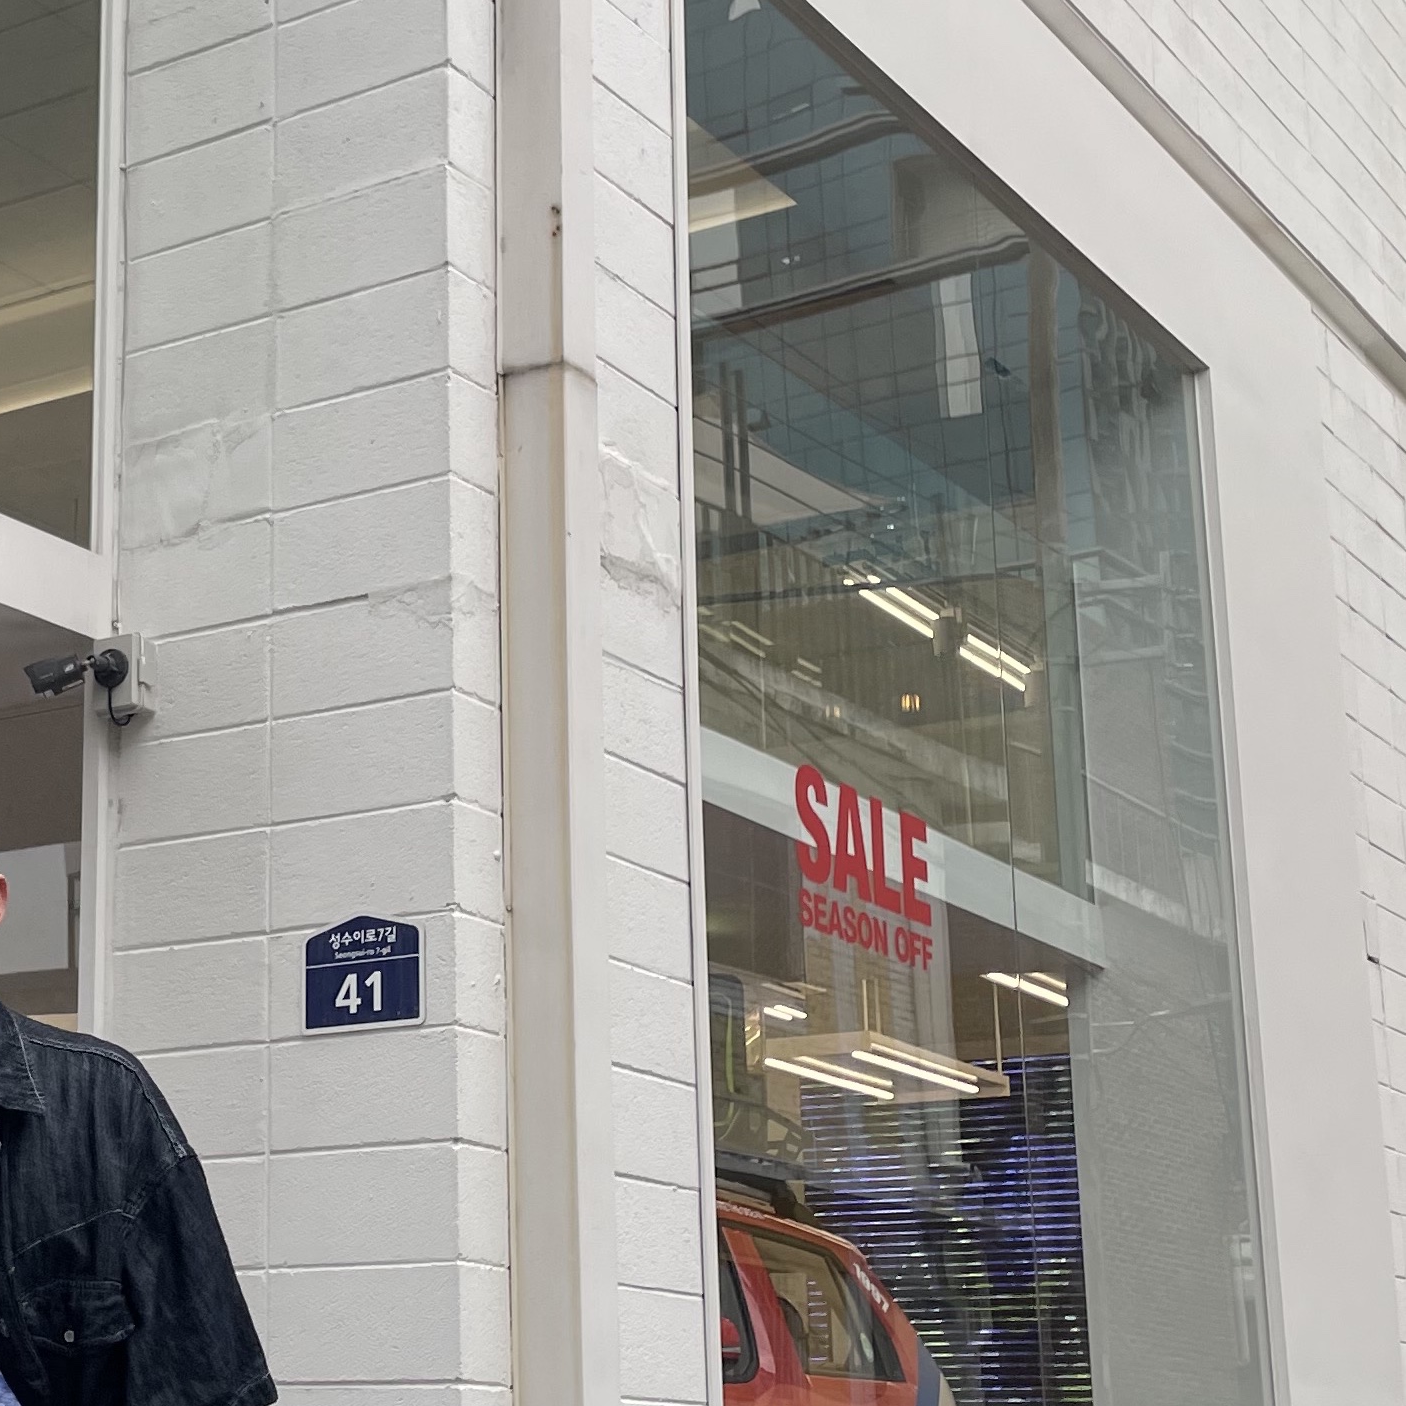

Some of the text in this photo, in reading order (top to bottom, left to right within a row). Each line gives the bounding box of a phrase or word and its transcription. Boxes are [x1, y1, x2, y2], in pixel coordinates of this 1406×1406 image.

[795, 764, 932, 927] SALE
[329, 925, 397, 950] 성수이로7길
[799, 888, 933, 971] SEASON OFF
[335, 970, 382, 1014] 41
